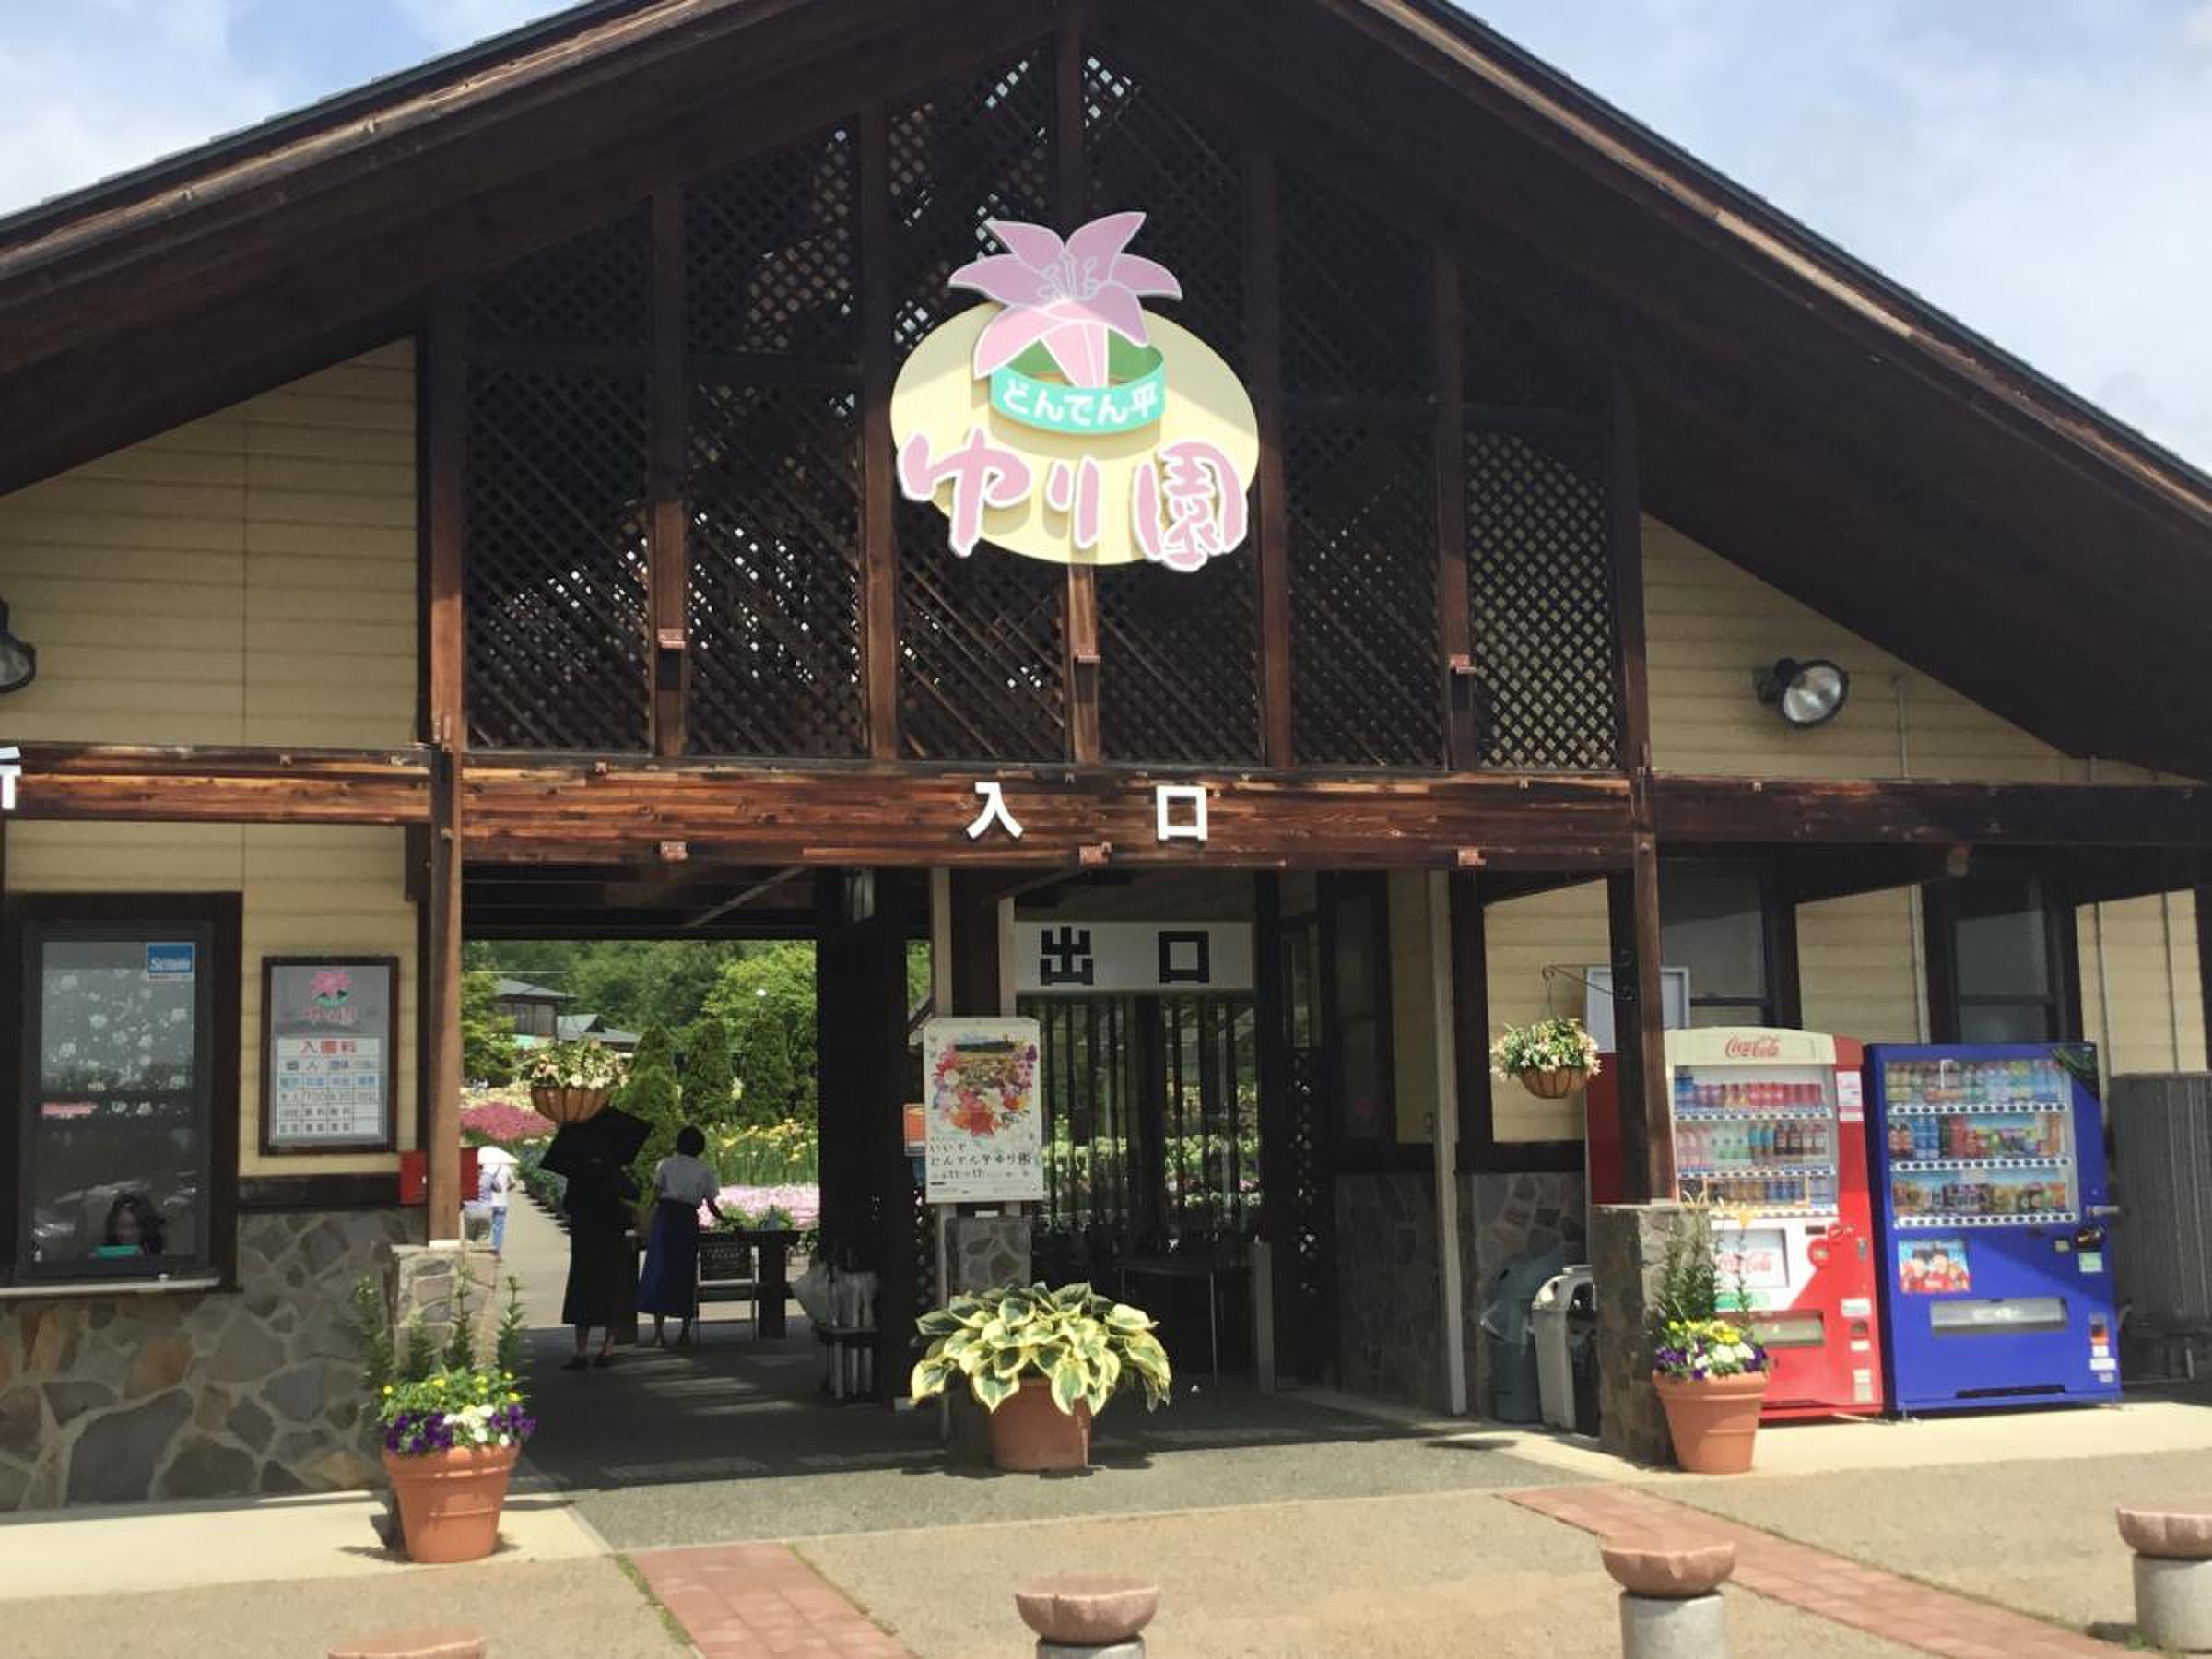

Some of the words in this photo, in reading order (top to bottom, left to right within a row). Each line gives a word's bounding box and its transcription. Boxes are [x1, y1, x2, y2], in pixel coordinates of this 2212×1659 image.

[1001, 381, 1160, 427] どんでん平
[897, 427, 1248, 572] ゆり園
[967, 781, 1209, 841] 入口
[1040, 926, 1210, 986] 出口
